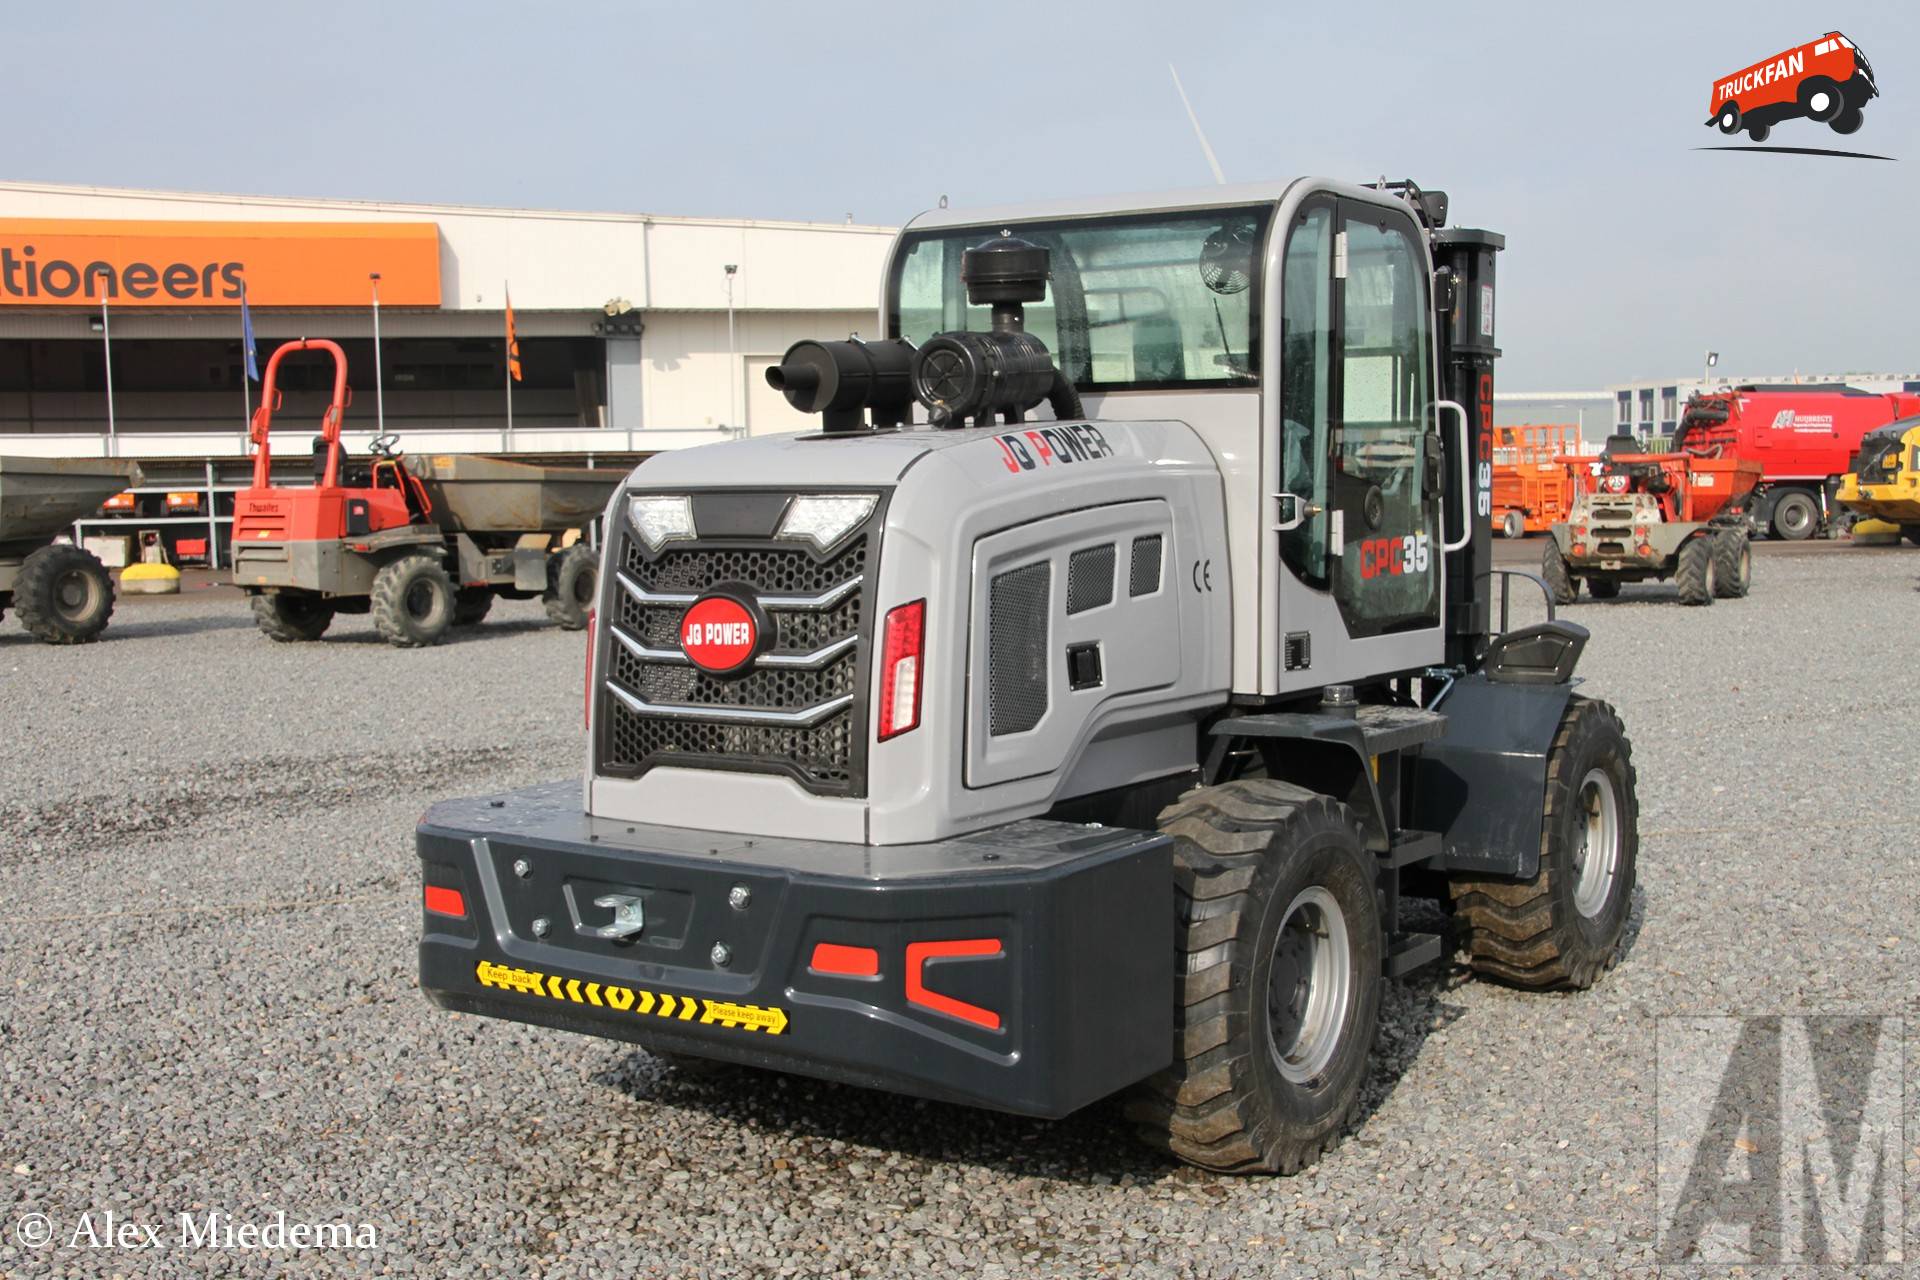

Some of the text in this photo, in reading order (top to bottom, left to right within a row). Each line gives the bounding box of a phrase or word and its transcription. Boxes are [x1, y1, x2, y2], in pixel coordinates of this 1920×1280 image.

[0, 245, 247, 299] tioneers
[1023, 424, 1115, 466] POWER
[1478, 373, 1492, 517] CPC35
[1360, 534, 1429, 579] CPC35
[686, 622, 750, 646] JG POWER
[487, 968, 532, 985] Keep back
[712, 1005, 776, 1025] Please keep away
